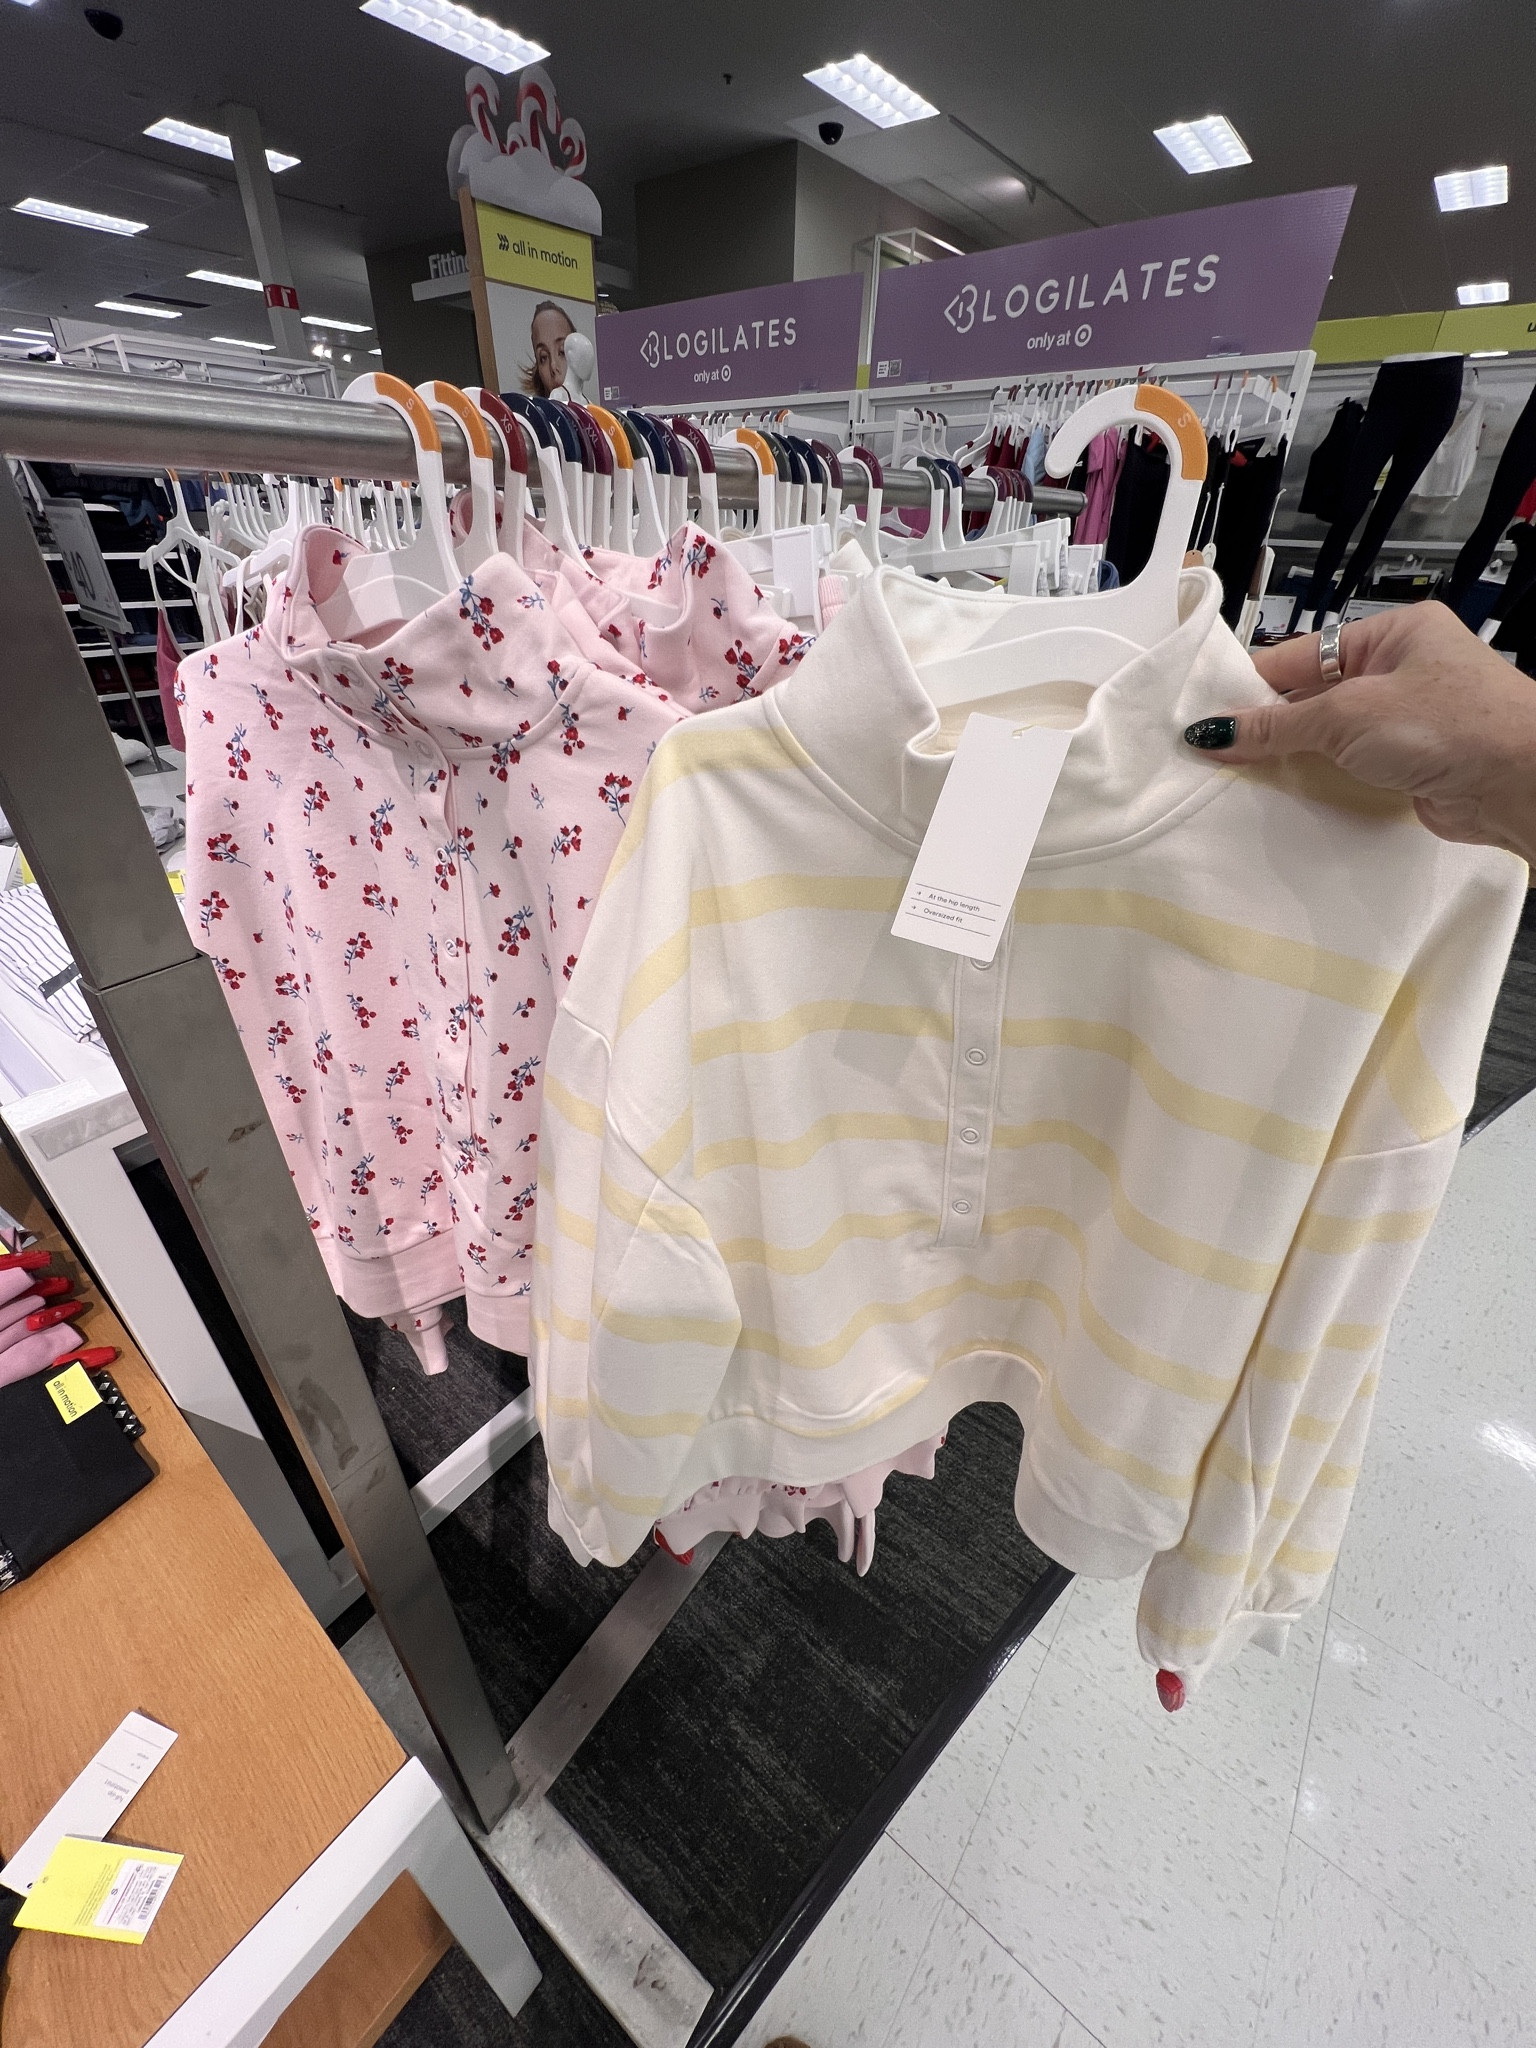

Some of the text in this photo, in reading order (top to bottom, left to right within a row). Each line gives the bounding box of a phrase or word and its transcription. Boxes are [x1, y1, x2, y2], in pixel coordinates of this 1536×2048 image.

[512, 240, 578, 270] all in motion
[943, 254, 1220, 334] BLOGILATES
[640, 317, 797, 368] BLOGILATES
[1026, 329, 1071, 350] only at
[693, 368, 719, 384] only at
[405, 398, 415, 410] S
[525, 404, 530, 417] L
[500, 413, 513, 434] XS
[1177, 412, 1192, 428] S
[585, 422, 599, 446] XXL
[608, 427, 615, 437] S
[662, 430, 672, 448] XL
[688, 429, 700, 449] XXL
[772, 446, 779, 457] M
[825, 452, 833, 466] XL
[923, 908, 954, 920] Oversized
[960, 901, 980, 912] length
[61, 1394, 78, 1418] motion
